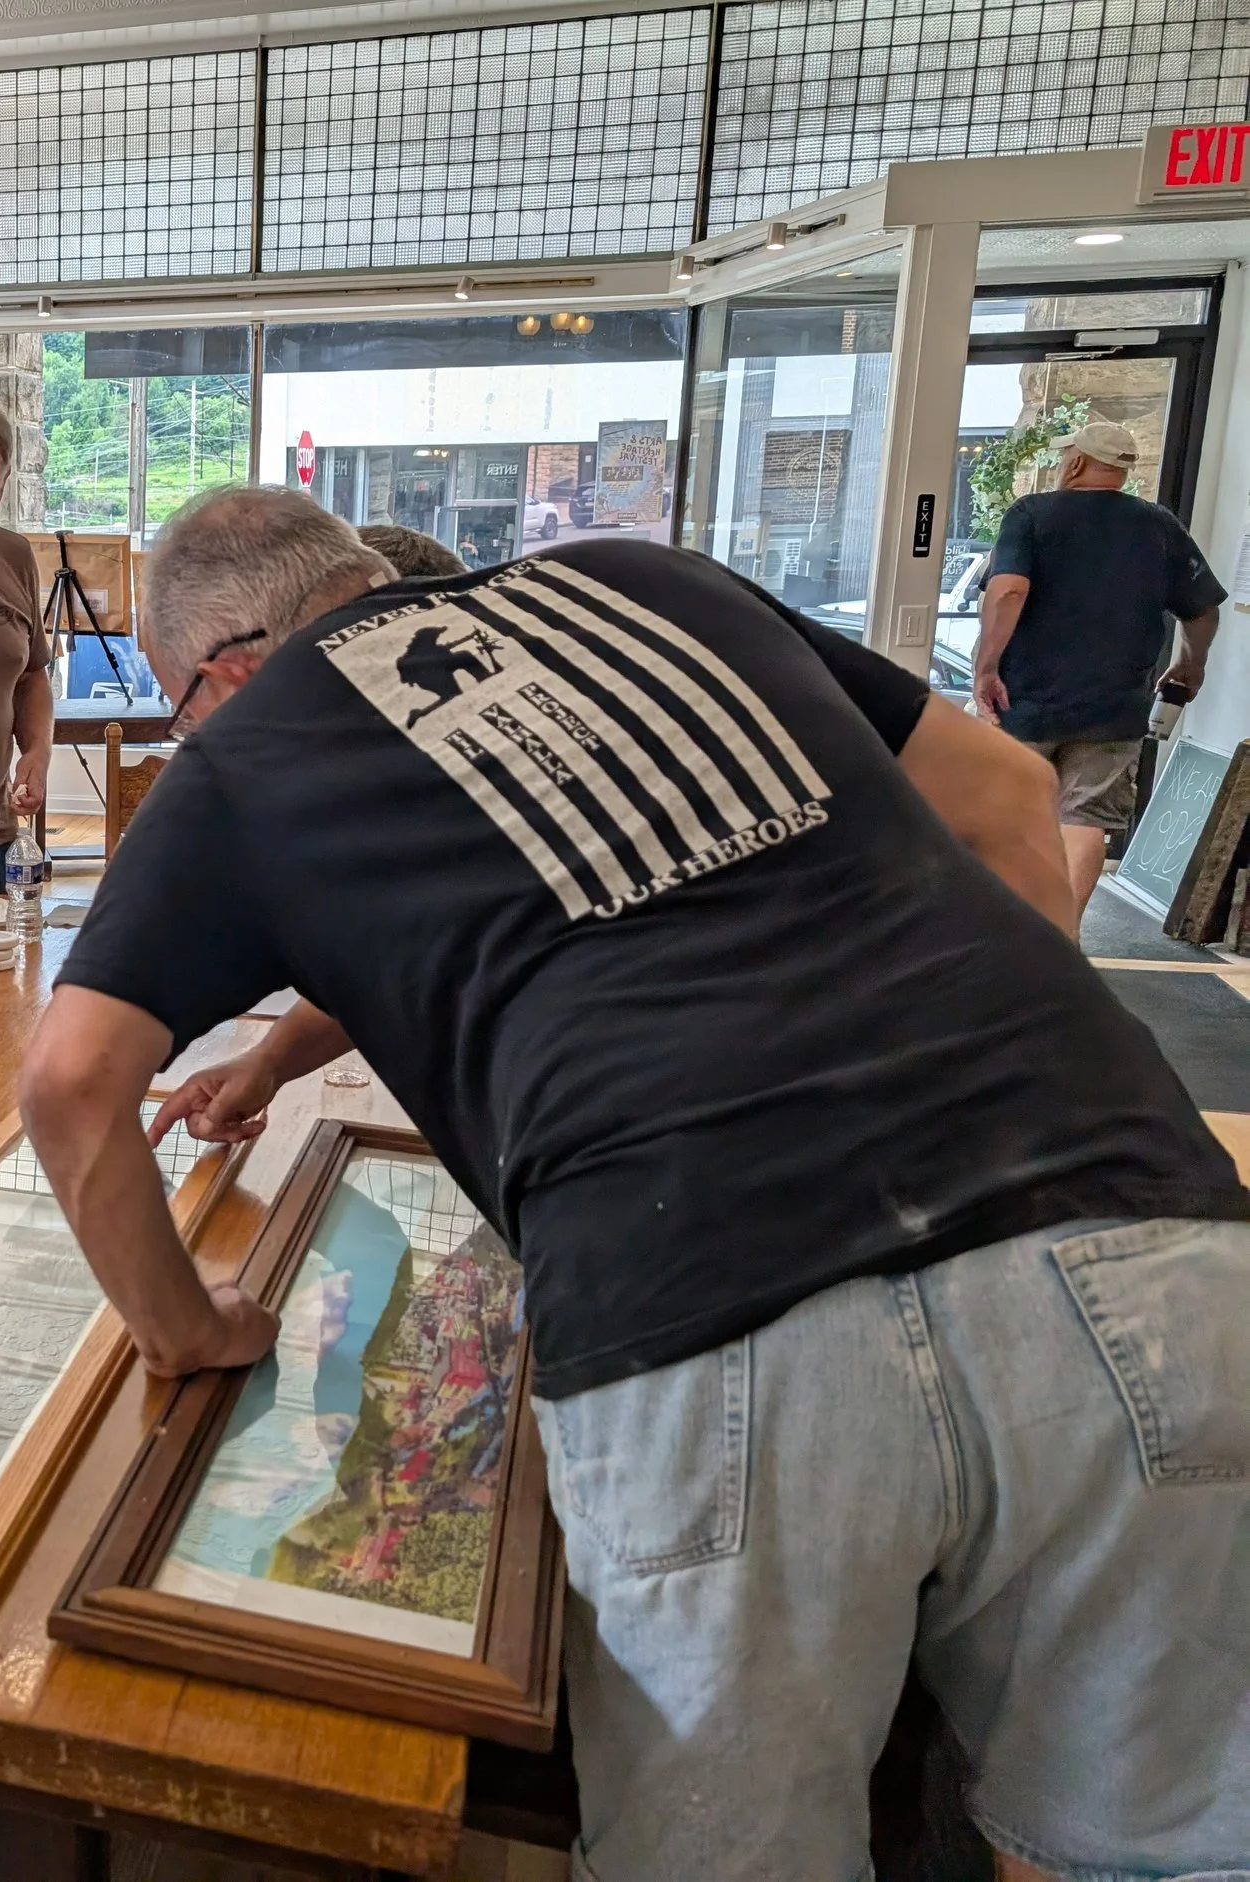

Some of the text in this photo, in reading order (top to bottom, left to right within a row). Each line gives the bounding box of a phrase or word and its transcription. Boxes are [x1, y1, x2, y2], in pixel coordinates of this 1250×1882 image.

[1165, 126, 1250, 186] EXIT
[298, 447, 314, 469] STOP
[918, 501, 930, 543] EXIT
[314, 603, 425, 655] NEVER
[481, 704, 575, 787] VALHALLA
[518, 683, 601, 752] PROJECT
[681, 801, 830, 880] HEROES
